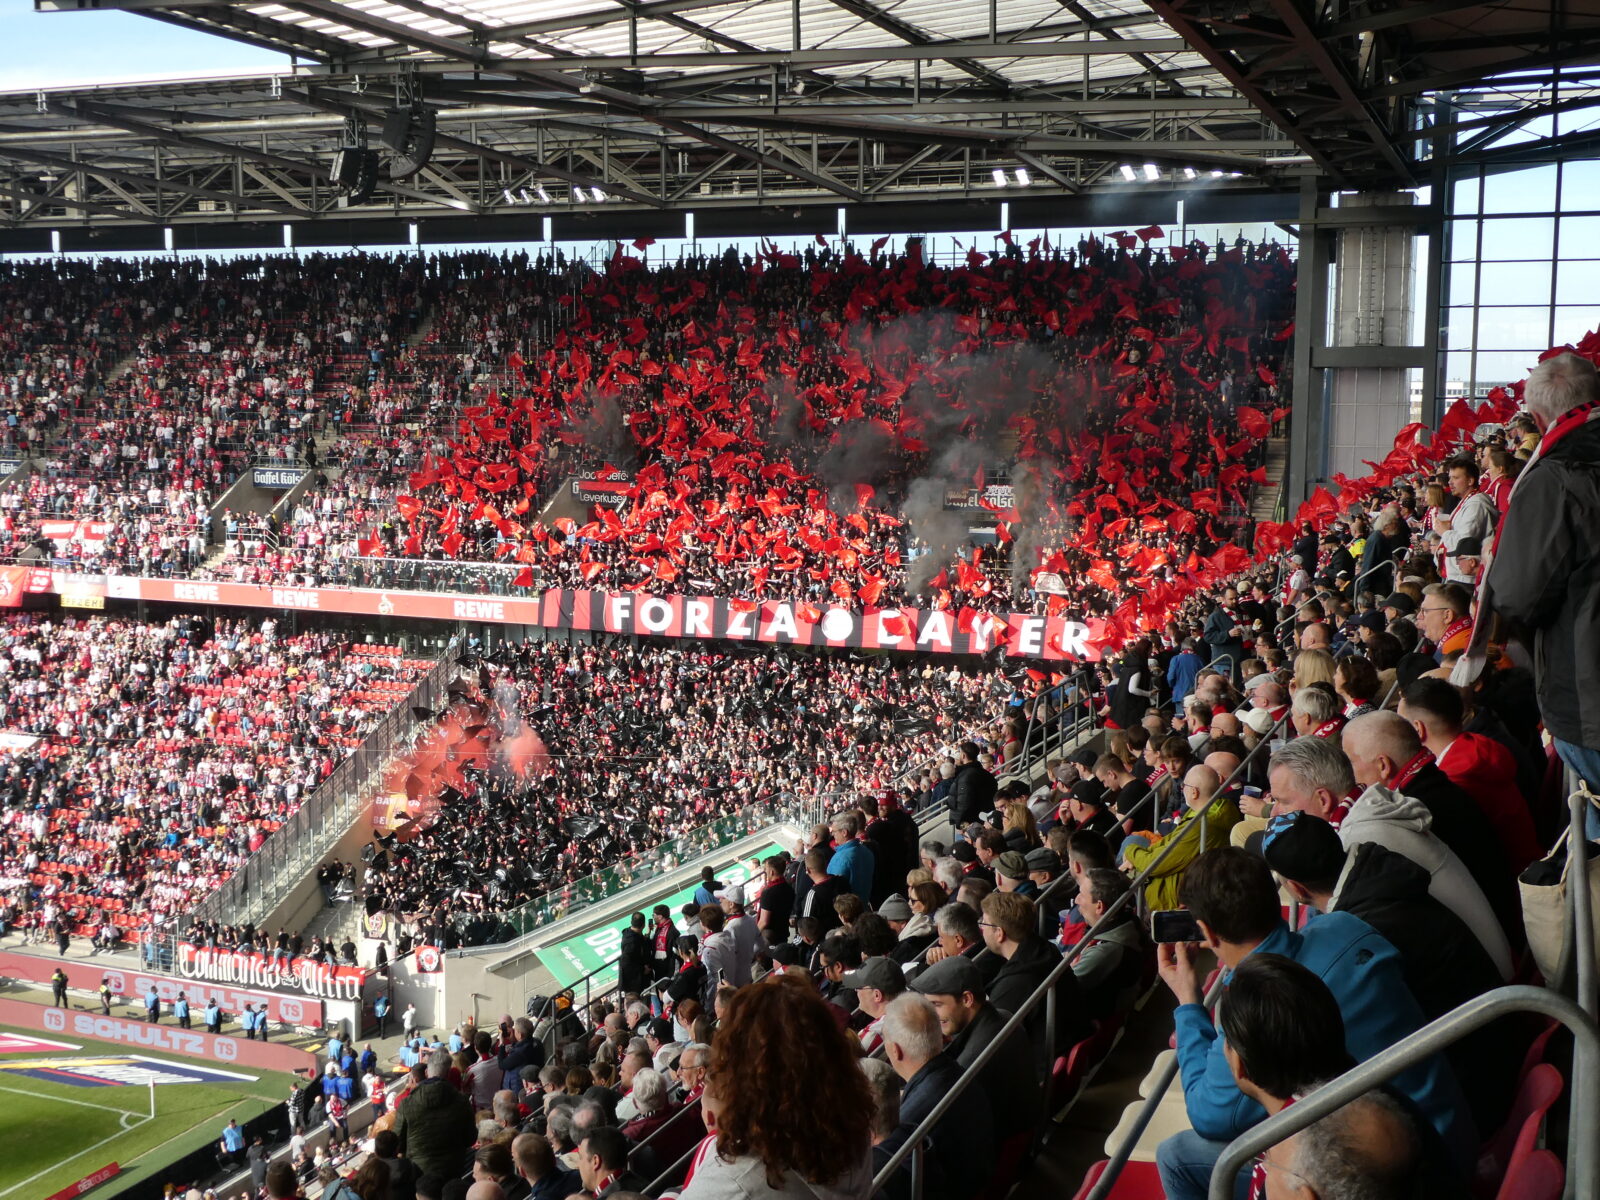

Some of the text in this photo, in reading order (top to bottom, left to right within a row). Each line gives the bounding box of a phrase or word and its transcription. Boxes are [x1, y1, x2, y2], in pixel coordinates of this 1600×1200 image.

[254, 471, 280, 485] Gaffel
[173, 583, 220, 601] REWE
[272, 589, 320, 609] REWE
[453, 600, 505, 620] REWE
[612, 597, 799, 639] FORZA
[135, 977, 269, 1016] SCHULTZ
[282, 1002, 300, 1018] TS
[47, 1013, 234, 1057] TS SCHULTZ TS
